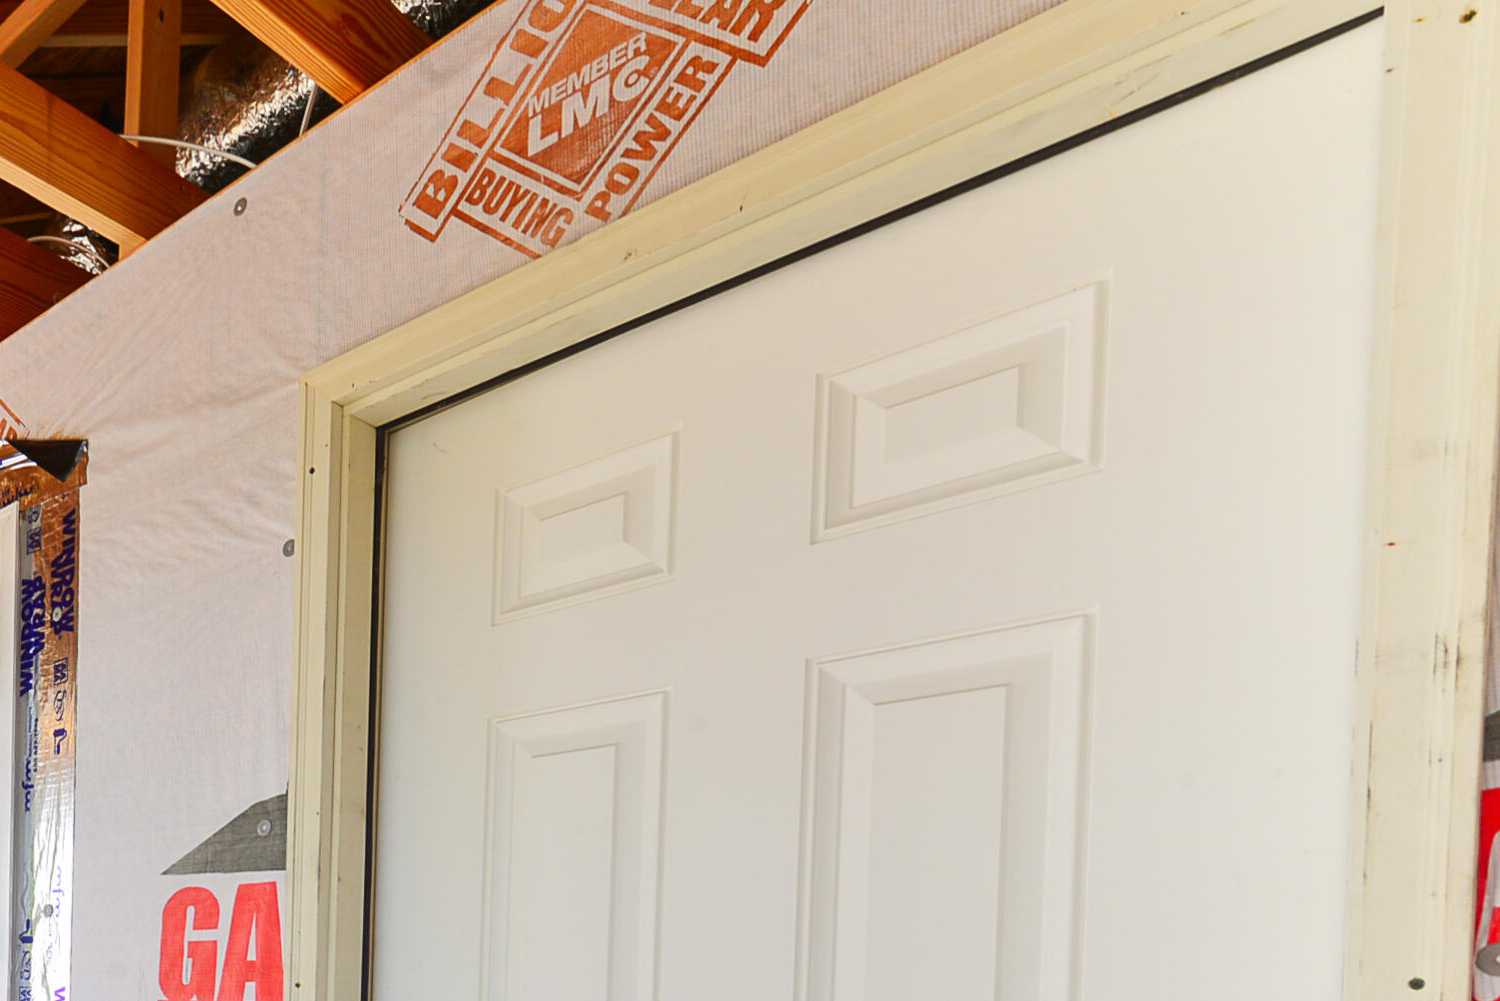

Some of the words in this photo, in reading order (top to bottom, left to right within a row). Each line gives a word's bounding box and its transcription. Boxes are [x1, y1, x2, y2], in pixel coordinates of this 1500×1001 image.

[526, 32, 649, 119] MEMBER
[527, 54, 652, 157] LMC
[466, 167, 575, 249] BUYING
[584, 54, 721, 223] POWER
[60, 508, 76, 633] WINDOW
